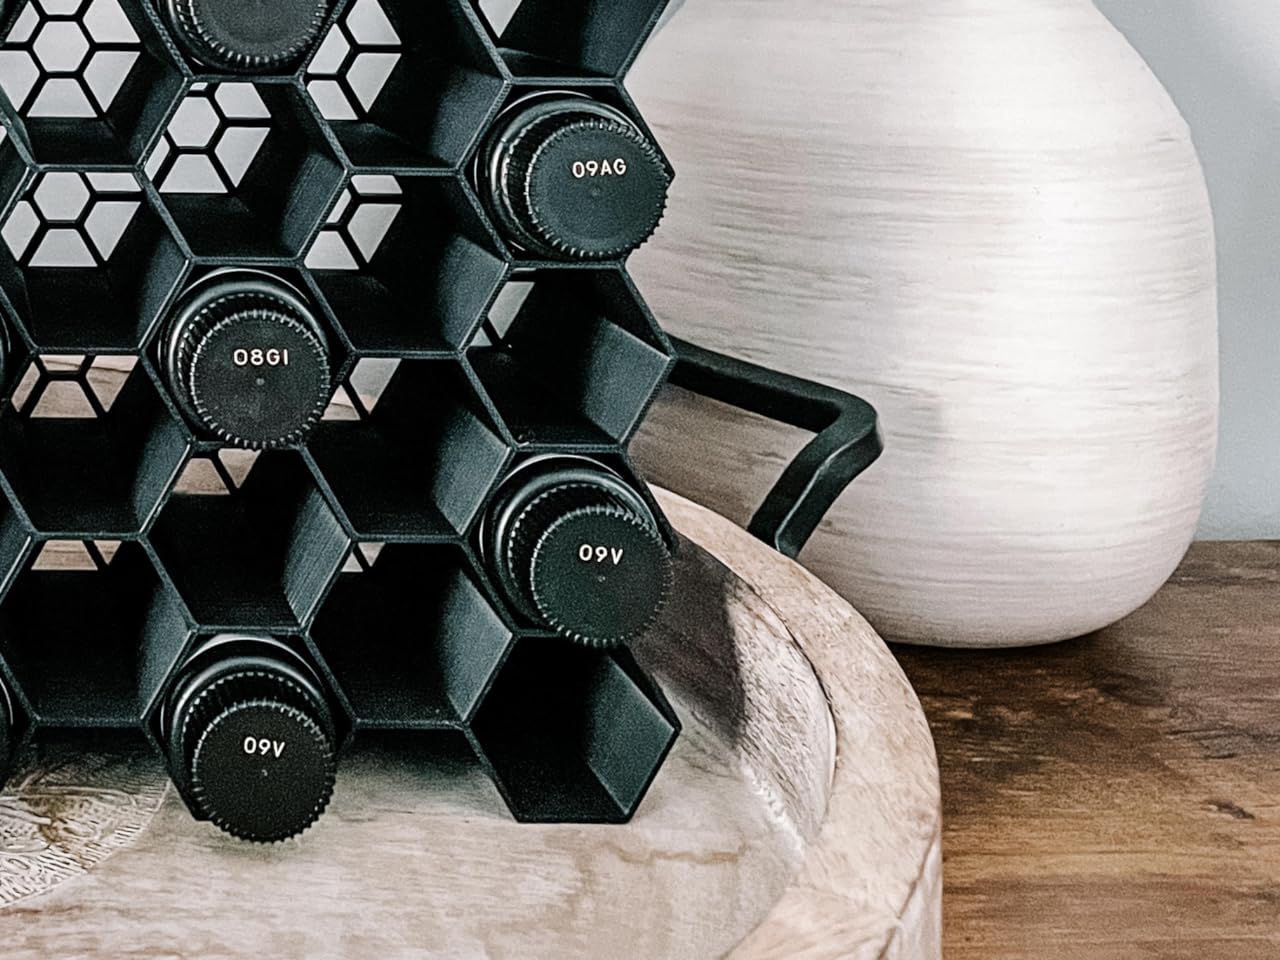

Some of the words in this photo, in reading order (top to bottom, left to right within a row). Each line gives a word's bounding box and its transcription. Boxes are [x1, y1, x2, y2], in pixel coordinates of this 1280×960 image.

[572, 158, 627, 180] 09AG
[579, 543, 624, 566] 09V
[243, 736, 286, 759] 09V
